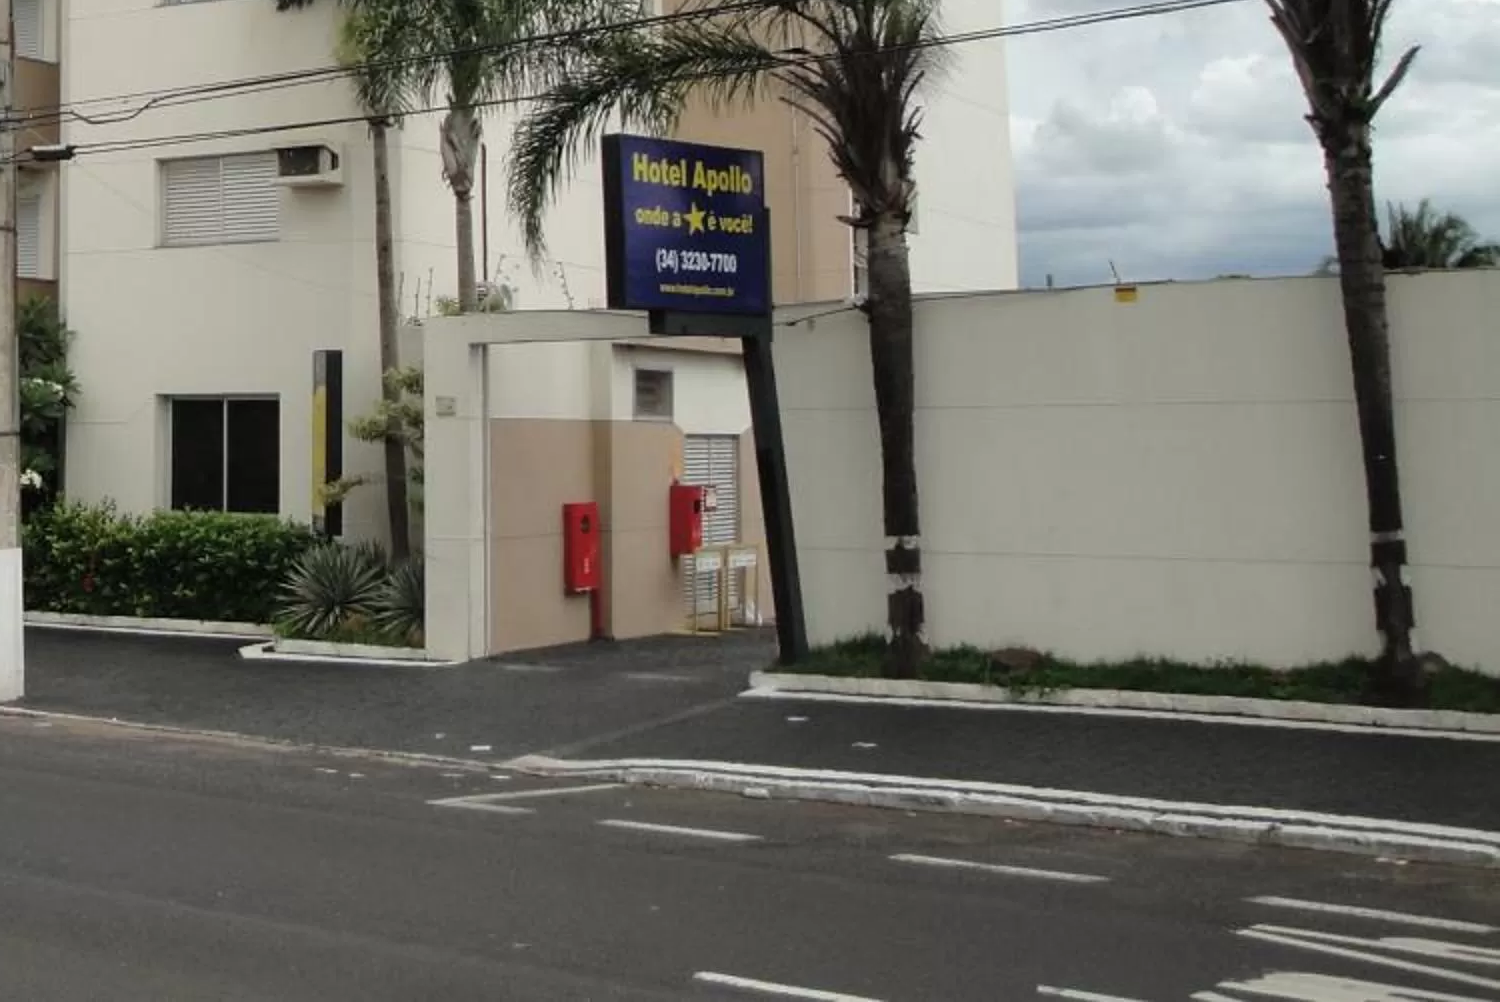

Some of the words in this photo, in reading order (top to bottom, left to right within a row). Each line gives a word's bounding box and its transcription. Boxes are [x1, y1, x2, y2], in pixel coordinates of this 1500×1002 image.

[632, 152, 687, 186] Hotel
[692, 160, 752, 196] Apollo
[634, 205, 669, 226] onde
[672, 211, 681, 228] a
[656, 248, 679, 273] (34)
